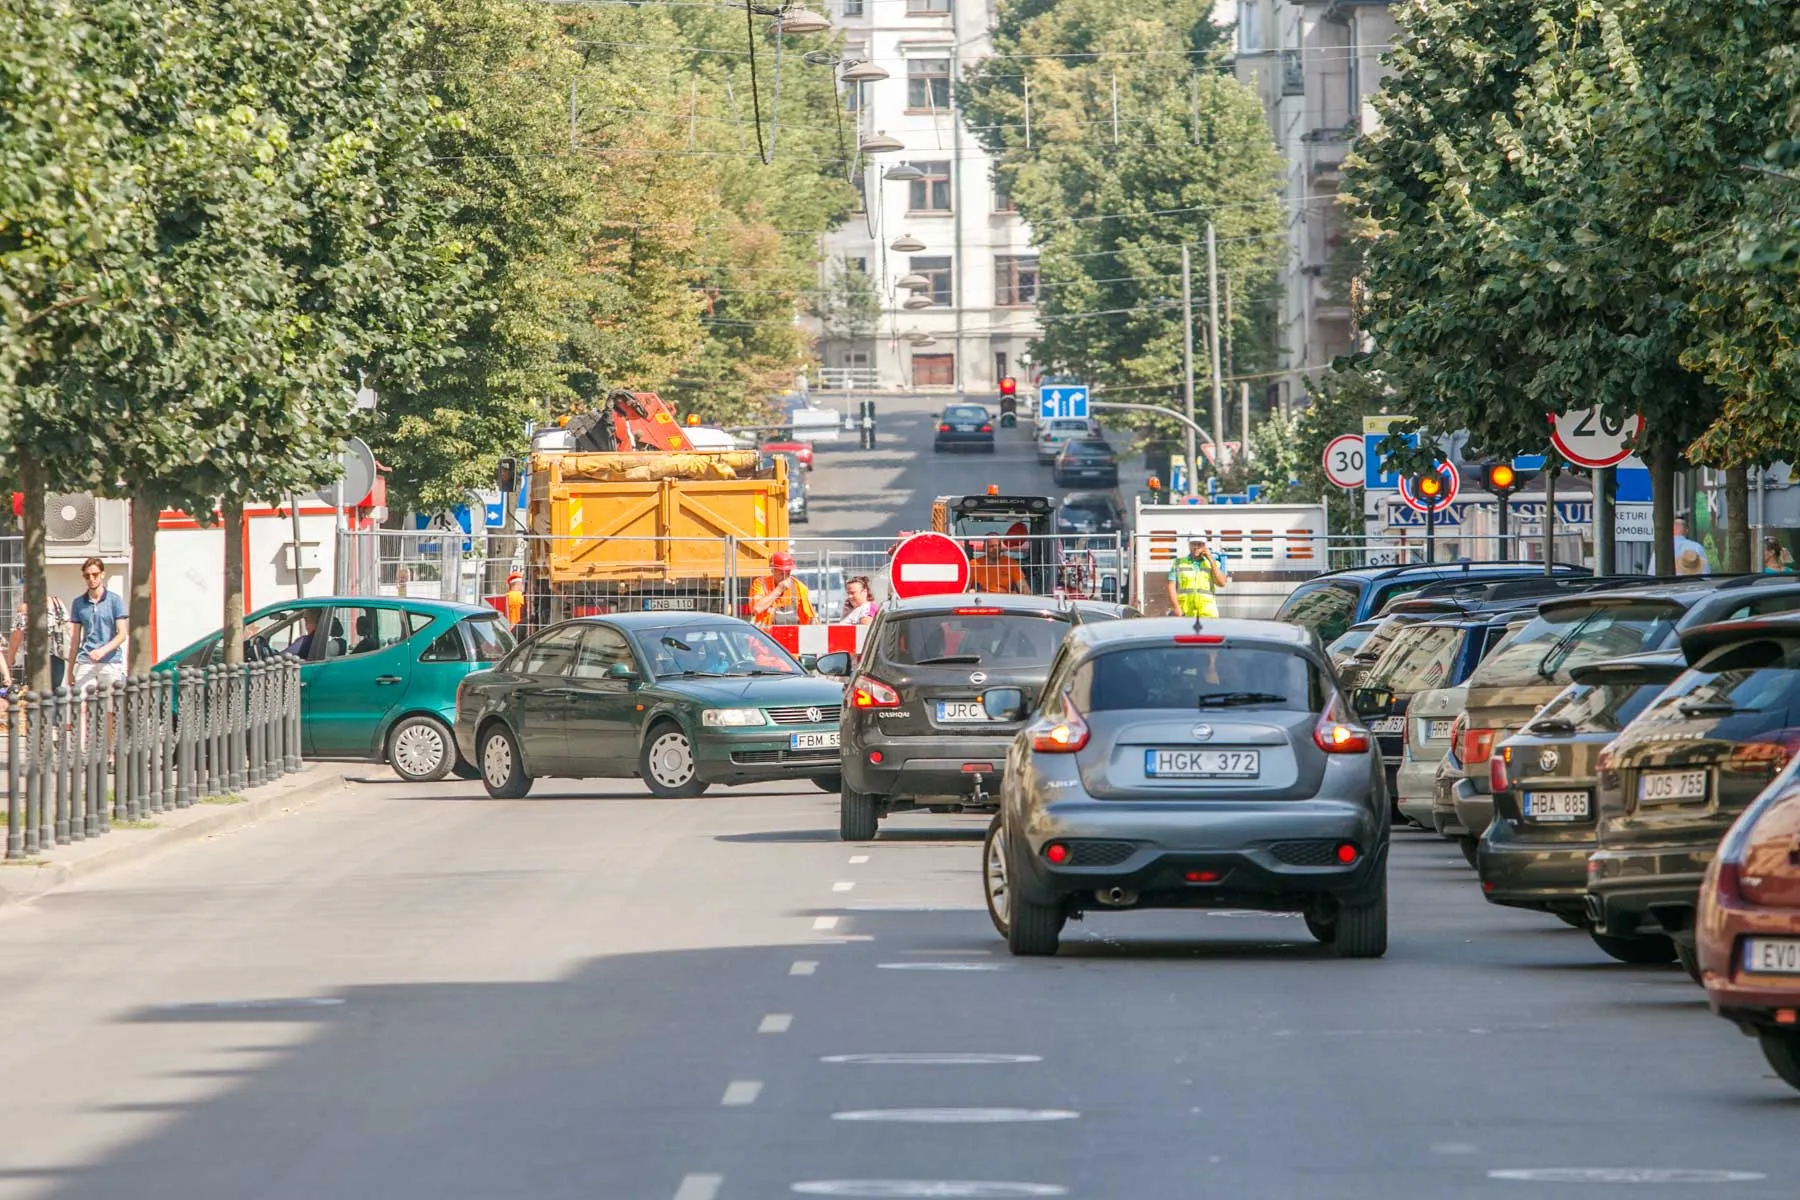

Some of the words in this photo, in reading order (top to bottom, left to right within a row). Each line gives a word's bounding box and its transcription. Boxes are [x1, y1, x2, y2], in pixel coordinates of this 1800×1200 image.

[1573, 402, 1625, 437] 20
[1335, 451, 1364, 472] 30
[677, 599, 693, 609] 110
[947, 703, 979, 718] JRC
[798, 735, 824, 747] FBM
[1159, 752, 1203, 771] HGK
[1217, 752, 1256, 771] 372
[1646, 775, 1673, 797] JOS
[1679, 773, 1704, 795] 755
[1531, 794, 1557, 814] HBA
[1563, 794, 1587, 814] 885
